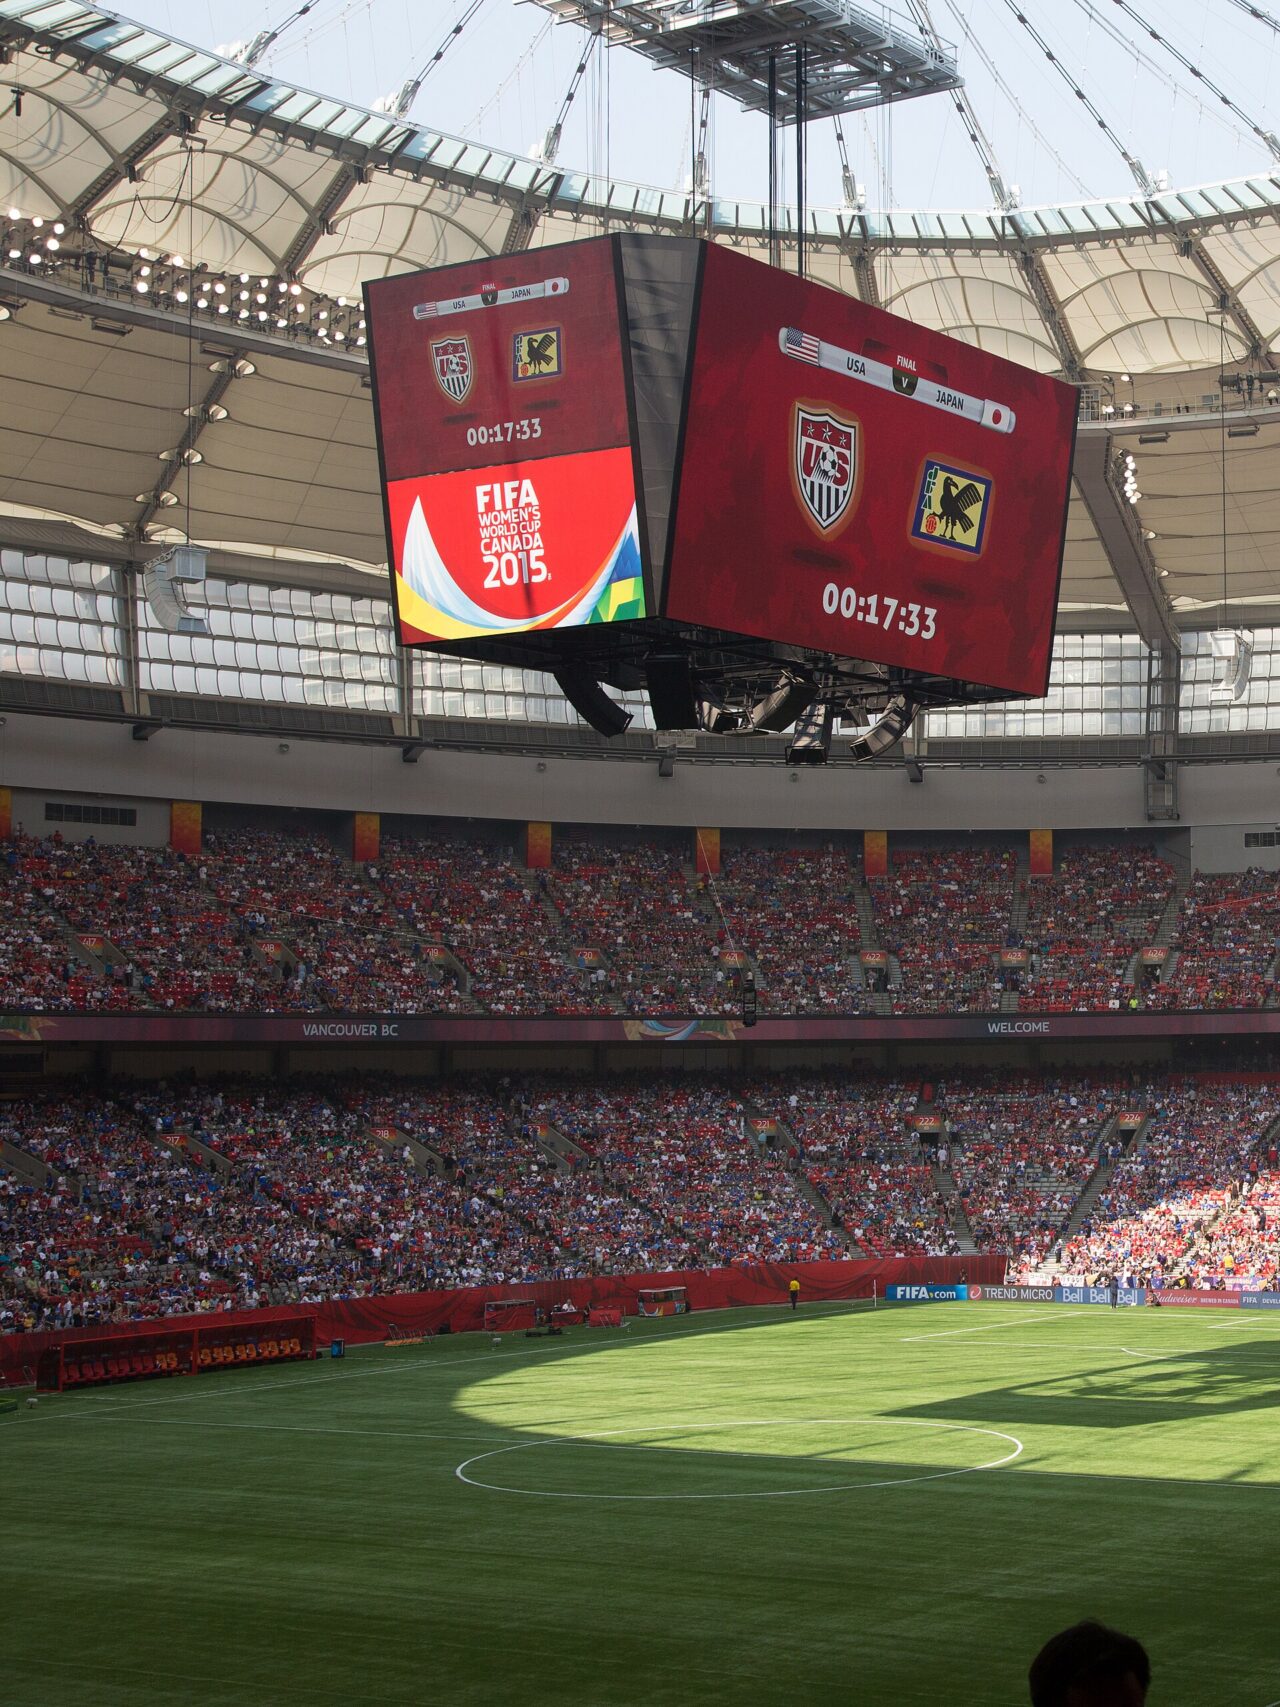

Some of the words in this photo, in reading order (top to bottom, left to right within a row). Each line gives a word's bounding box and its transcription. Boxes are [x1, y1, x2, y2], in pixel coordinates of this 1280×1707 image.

[481, 282, 496, 291] FINAL
[453, 300, 466, 310] USA
[511, 287, 531, 299] JAPAN
[896, 355, 917, 371] FINAL
[846, 356, 866, 376] USA
[935, 390, 964, 411] JAPAN
[466, 418, 542, 447] 00:17:33
[475, 479, 539, 513] FIFA
[478, 506, 541, 527] WOMEN'S
[479, 523, 518, 538] WORLD
[520, 520, 541, 533] CUP
[480, 532, 544, 555] CANADA
[482, 548, 548, 589] 2015
[822, 582, 938, 640] 00:17:33
[82, 937, 97, 946] 417
[261, 943, 275, 952] 418
[303, 1024, 377, 1036] VANCOUVER
[381, 1024, 398, 1036] BC
[987, 1021, 1050, 1033] WELCOME
[756, 1120, 770, 1128] 221
[920, 1117, 934, 1125] 222
[1124, 1113, 1140, 1121] 224
[984, 1287, 1018, 1299] TREND
[1020, 1288, 1053, 1300] MICRO
[1062, 1288, 1084, 1303] Bell
[1089, 1288, 1110, 1303] Bell
[1117, 1289, 1138, 1304] Bell
